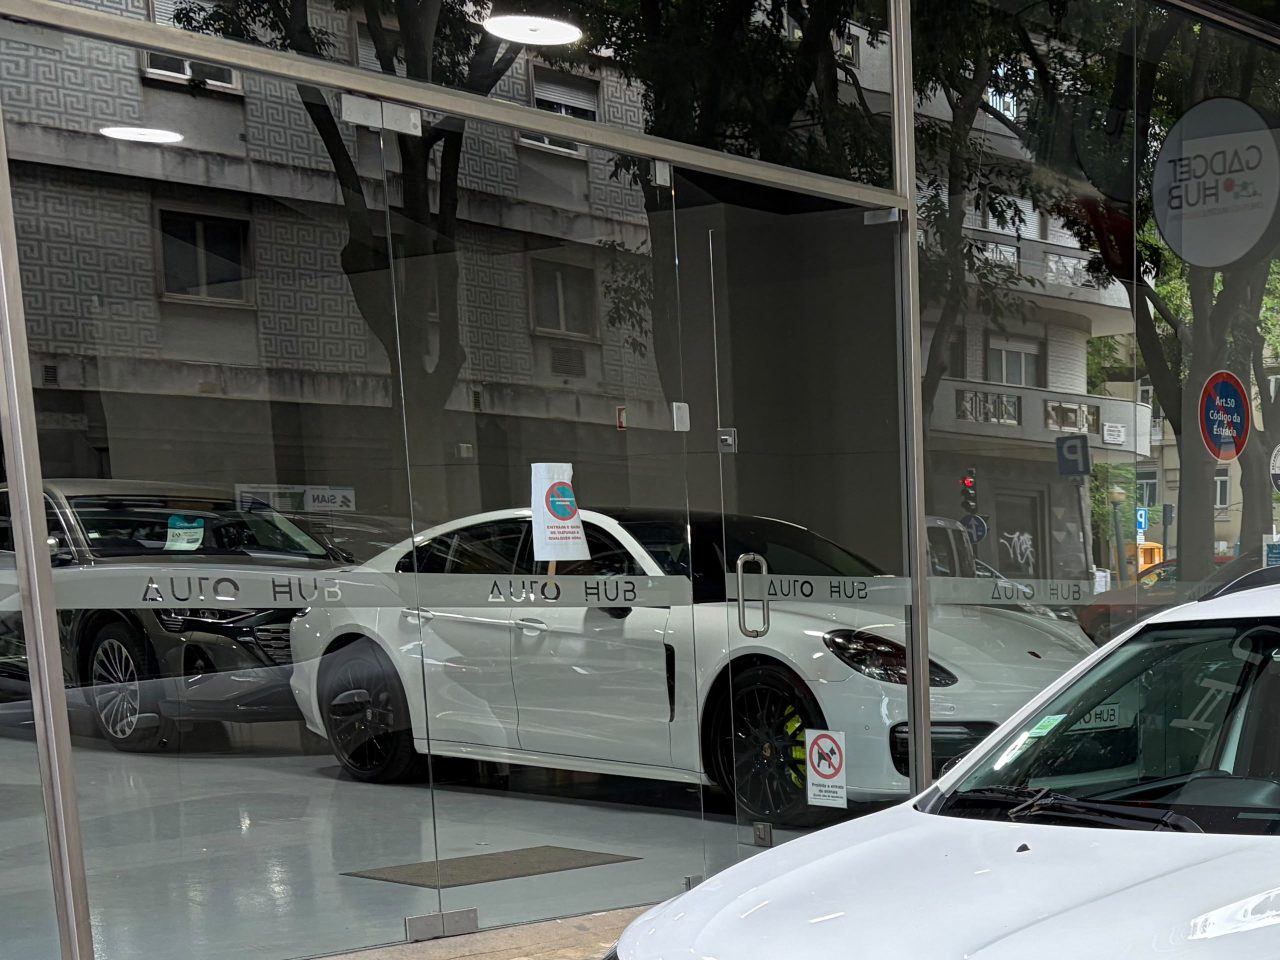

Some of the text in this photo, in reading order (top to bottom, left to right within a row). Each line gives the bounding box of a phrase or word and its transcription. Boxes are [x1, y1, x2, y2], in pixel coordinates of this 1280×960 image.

[1215, 396, 1236, 408] Art.50
[1209, 410, 1241, 423] Código da
[1213, 426, 1237, 436] Estrada
[142, 576, 342, 602] AUTO HUB
[488, 579, 637, 603] AUTO HUB
[767, 579, 814, 598] AUTO
[992, 583, 1081, 601] AUTO HUB
